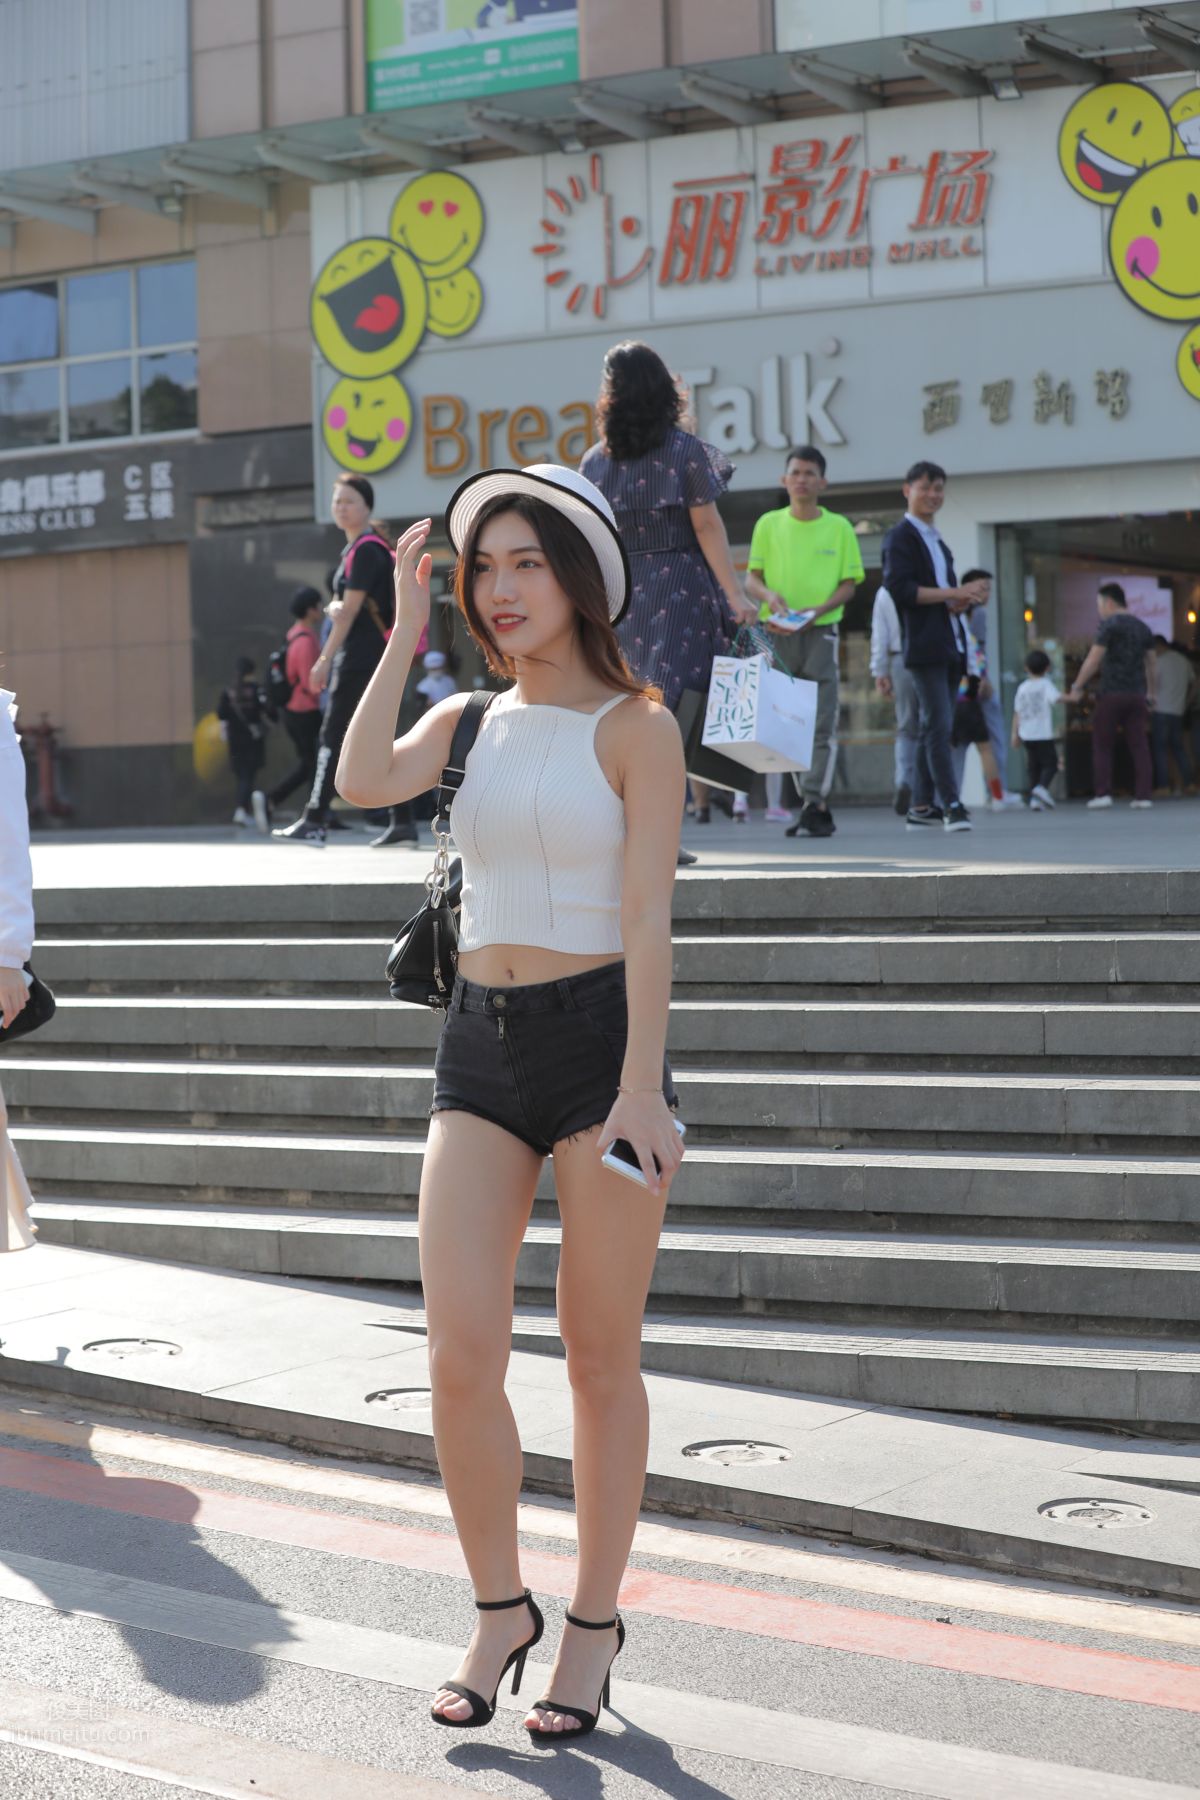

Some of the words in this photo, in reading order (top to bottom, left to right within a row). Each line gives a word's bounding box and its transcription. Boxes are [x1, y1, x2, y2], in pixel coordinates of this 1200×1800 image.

[658, 134, 994, 288] 丽影广场
[755, 246, 873, 276] LIVING
[888, 236, 982, 264] MALL
[39, 506, 96, 532] CLUB
